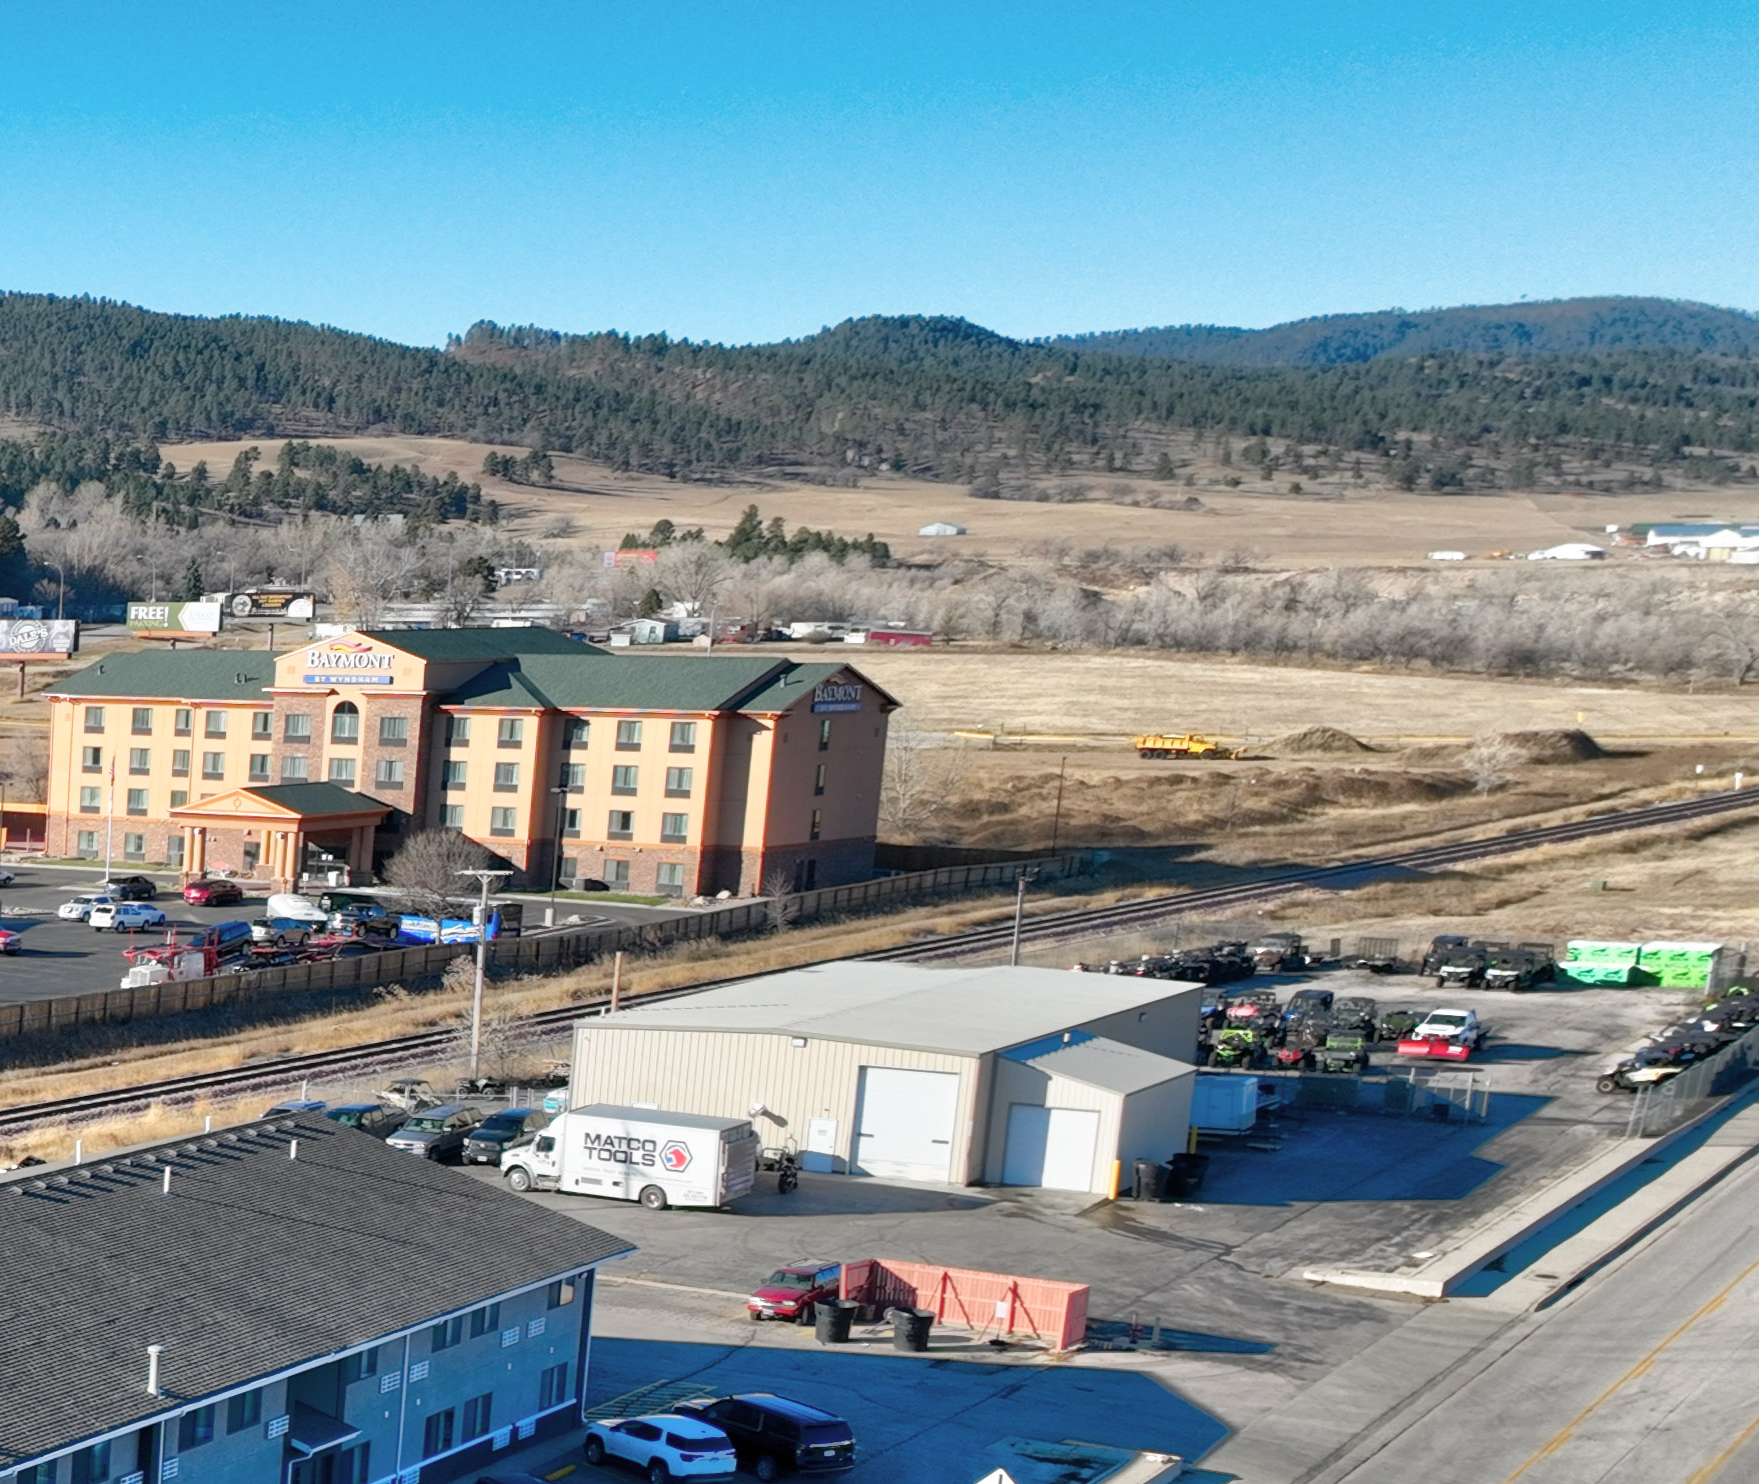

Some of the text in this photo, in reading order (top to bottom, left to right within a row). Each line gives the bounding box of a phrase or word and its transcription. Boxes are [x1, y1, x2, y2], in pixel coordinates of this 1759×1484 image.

[130, 606, 169, 628] FREE!
[9, 628, 48, 646] DALE'S
[306, 649, 394, 669] BAYMONT
[814, 684, 863, 702] BAYMONT
[584, 1132, 657, 1153] MATCO
[584, 1146, 656, 1167] TOOLS
